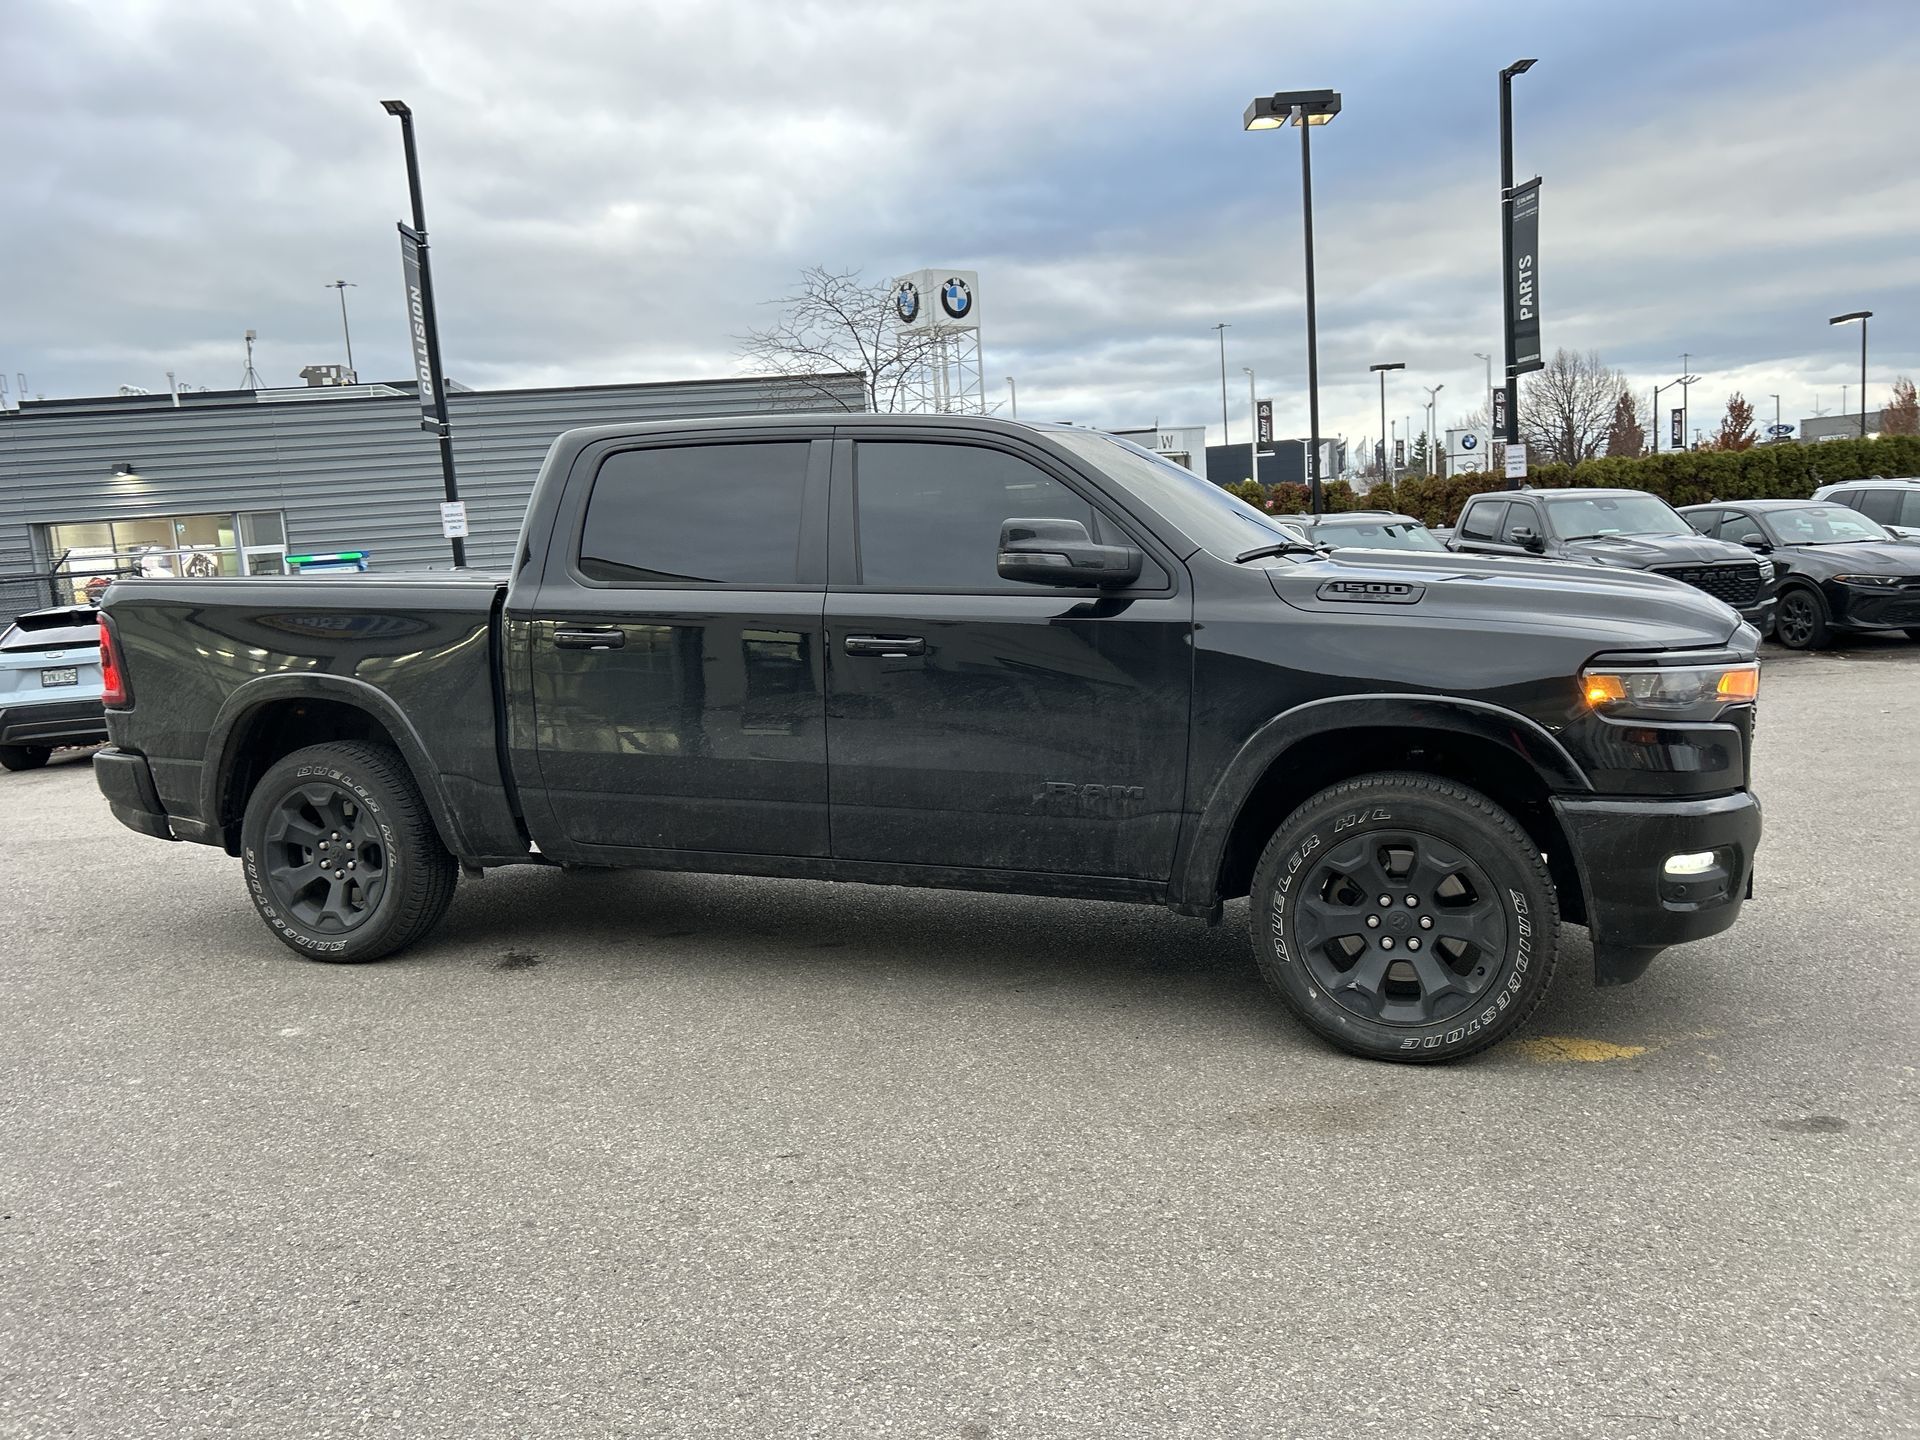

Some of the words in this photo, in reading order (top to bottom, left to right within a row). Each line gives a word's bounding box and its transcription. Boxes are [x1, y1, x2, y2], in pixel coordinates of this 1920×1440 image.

[1519, 254, 1533, 320] PARTS
[411, 286, 432, 396] COLLISION
[1335, 582, 1409, 595] 1500
[297, 766, 381, 813] DUELER
[1040, 781, 1145, 802] RAM
[246, 847, 348, 951] BRIDGESTONE
[1271, 834, 1321, 962] DUELER
[1334, 808, 1392, 833] H/L
[1400, 889, 1532, 1050] BRIDGESTONE
